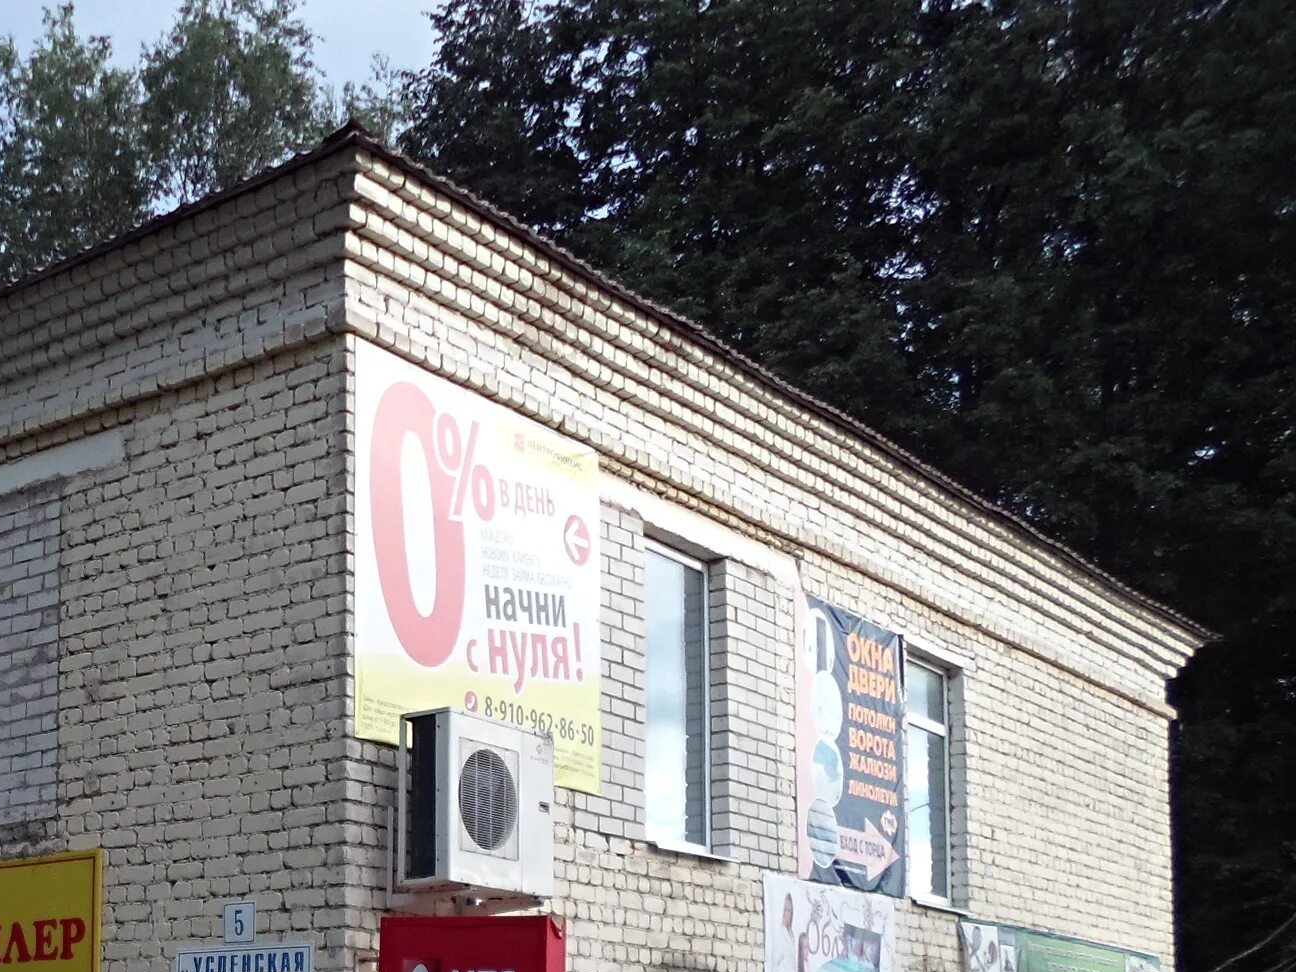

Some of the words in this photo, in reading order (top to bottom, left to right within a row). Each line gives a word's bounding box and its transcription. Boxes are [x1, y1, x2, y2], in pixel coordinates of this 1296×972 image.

[514, 481, 556, 517] ДЕНЬ
[484, 583, 567, 629] начни
[487, 622, 584, 694] нуля!
[846, 632, 895, 673] ОКНА
[847, 664, 896, 704] ДВЕРИ
[848, 703, 896, 734] ПОТОЛКИ
[848, 727, 896, 761] ВОРОТА
[849, 751, 897, 782] ЖАЛЮЗИ
[848, 779, 898, 807] ЛИНОЛЕУМ
[840, 834, 859, 855] ВХОД
[233, 909, 244, 937] 5
